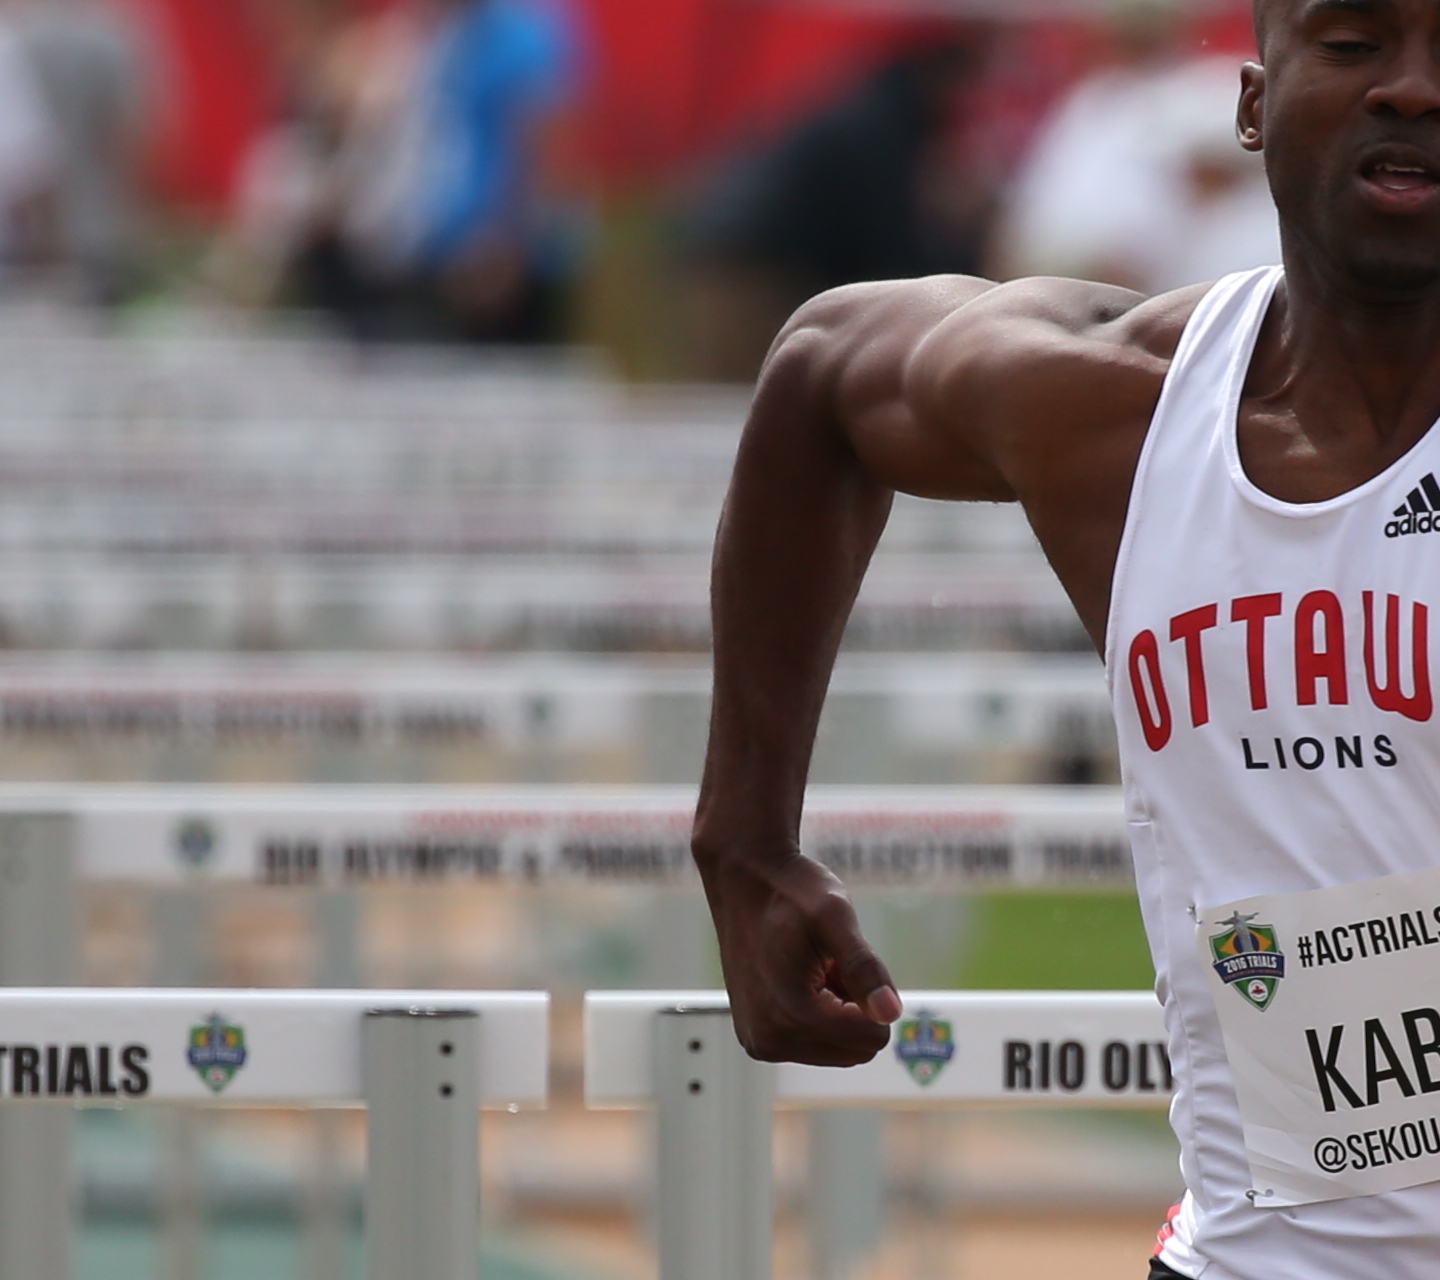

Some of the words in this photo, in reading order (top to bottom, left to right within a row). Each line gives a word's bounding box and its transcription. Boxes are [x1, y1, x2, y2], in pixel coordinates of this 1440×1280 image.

[1241, 734, 1398, 771] LIONS
[1223, 957, 1247, 974] 2016
[1247, 954, 1278, 969] TRIALS
[1004, 1040, 1086, 1091] RIO
